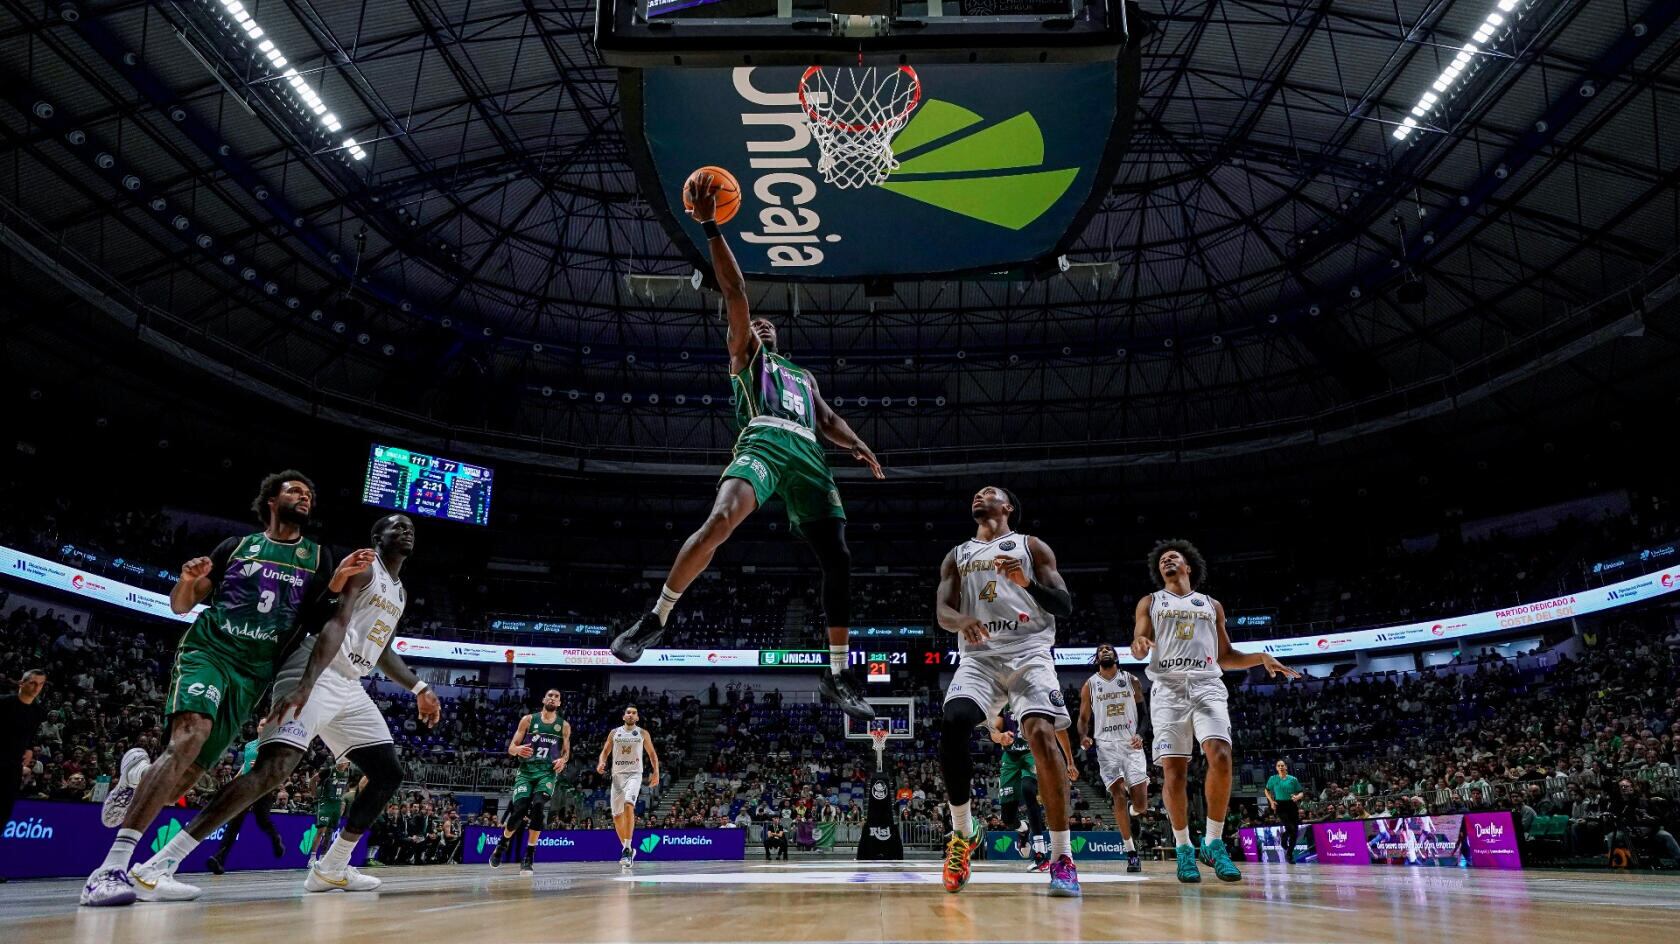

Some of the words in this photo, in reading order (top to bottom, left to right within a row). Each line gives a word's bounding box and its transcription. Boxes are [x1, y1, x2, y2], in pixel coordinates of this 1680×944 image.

[782, 389, 805, 416] 55
[411, 456, 426, 467] 111
[443, 463, 456, 473] 77
[422, 481, 443, 492] 2:21
[262, 567, 304, 588] Unicaja
[979, 581, 998, 603] 4
[256, 590, 276, 614] 3
[1495, 607, 1529, 619] PARTIDO
[1530, 597, 1569, 613] DEDICADO
[1569, 596, 1576, 604] A
[1501, 616, 1534, 628] COSTA
[1535, 612, 1553, 622] DEL
[220, 618, 279, 643] Andalucía
[782, 653, 823, 664] UNICAJA
[870, 653, 887, 661] 2:21
[924, 652, 941, 665] 21
[870, 663, 886, 675] 21
[536, 747, 549, 759] 27
[3, 817, 54, 839] ación
[869, 826, 891, 841] Risi
[662, 835, 712, 845] Fundación
